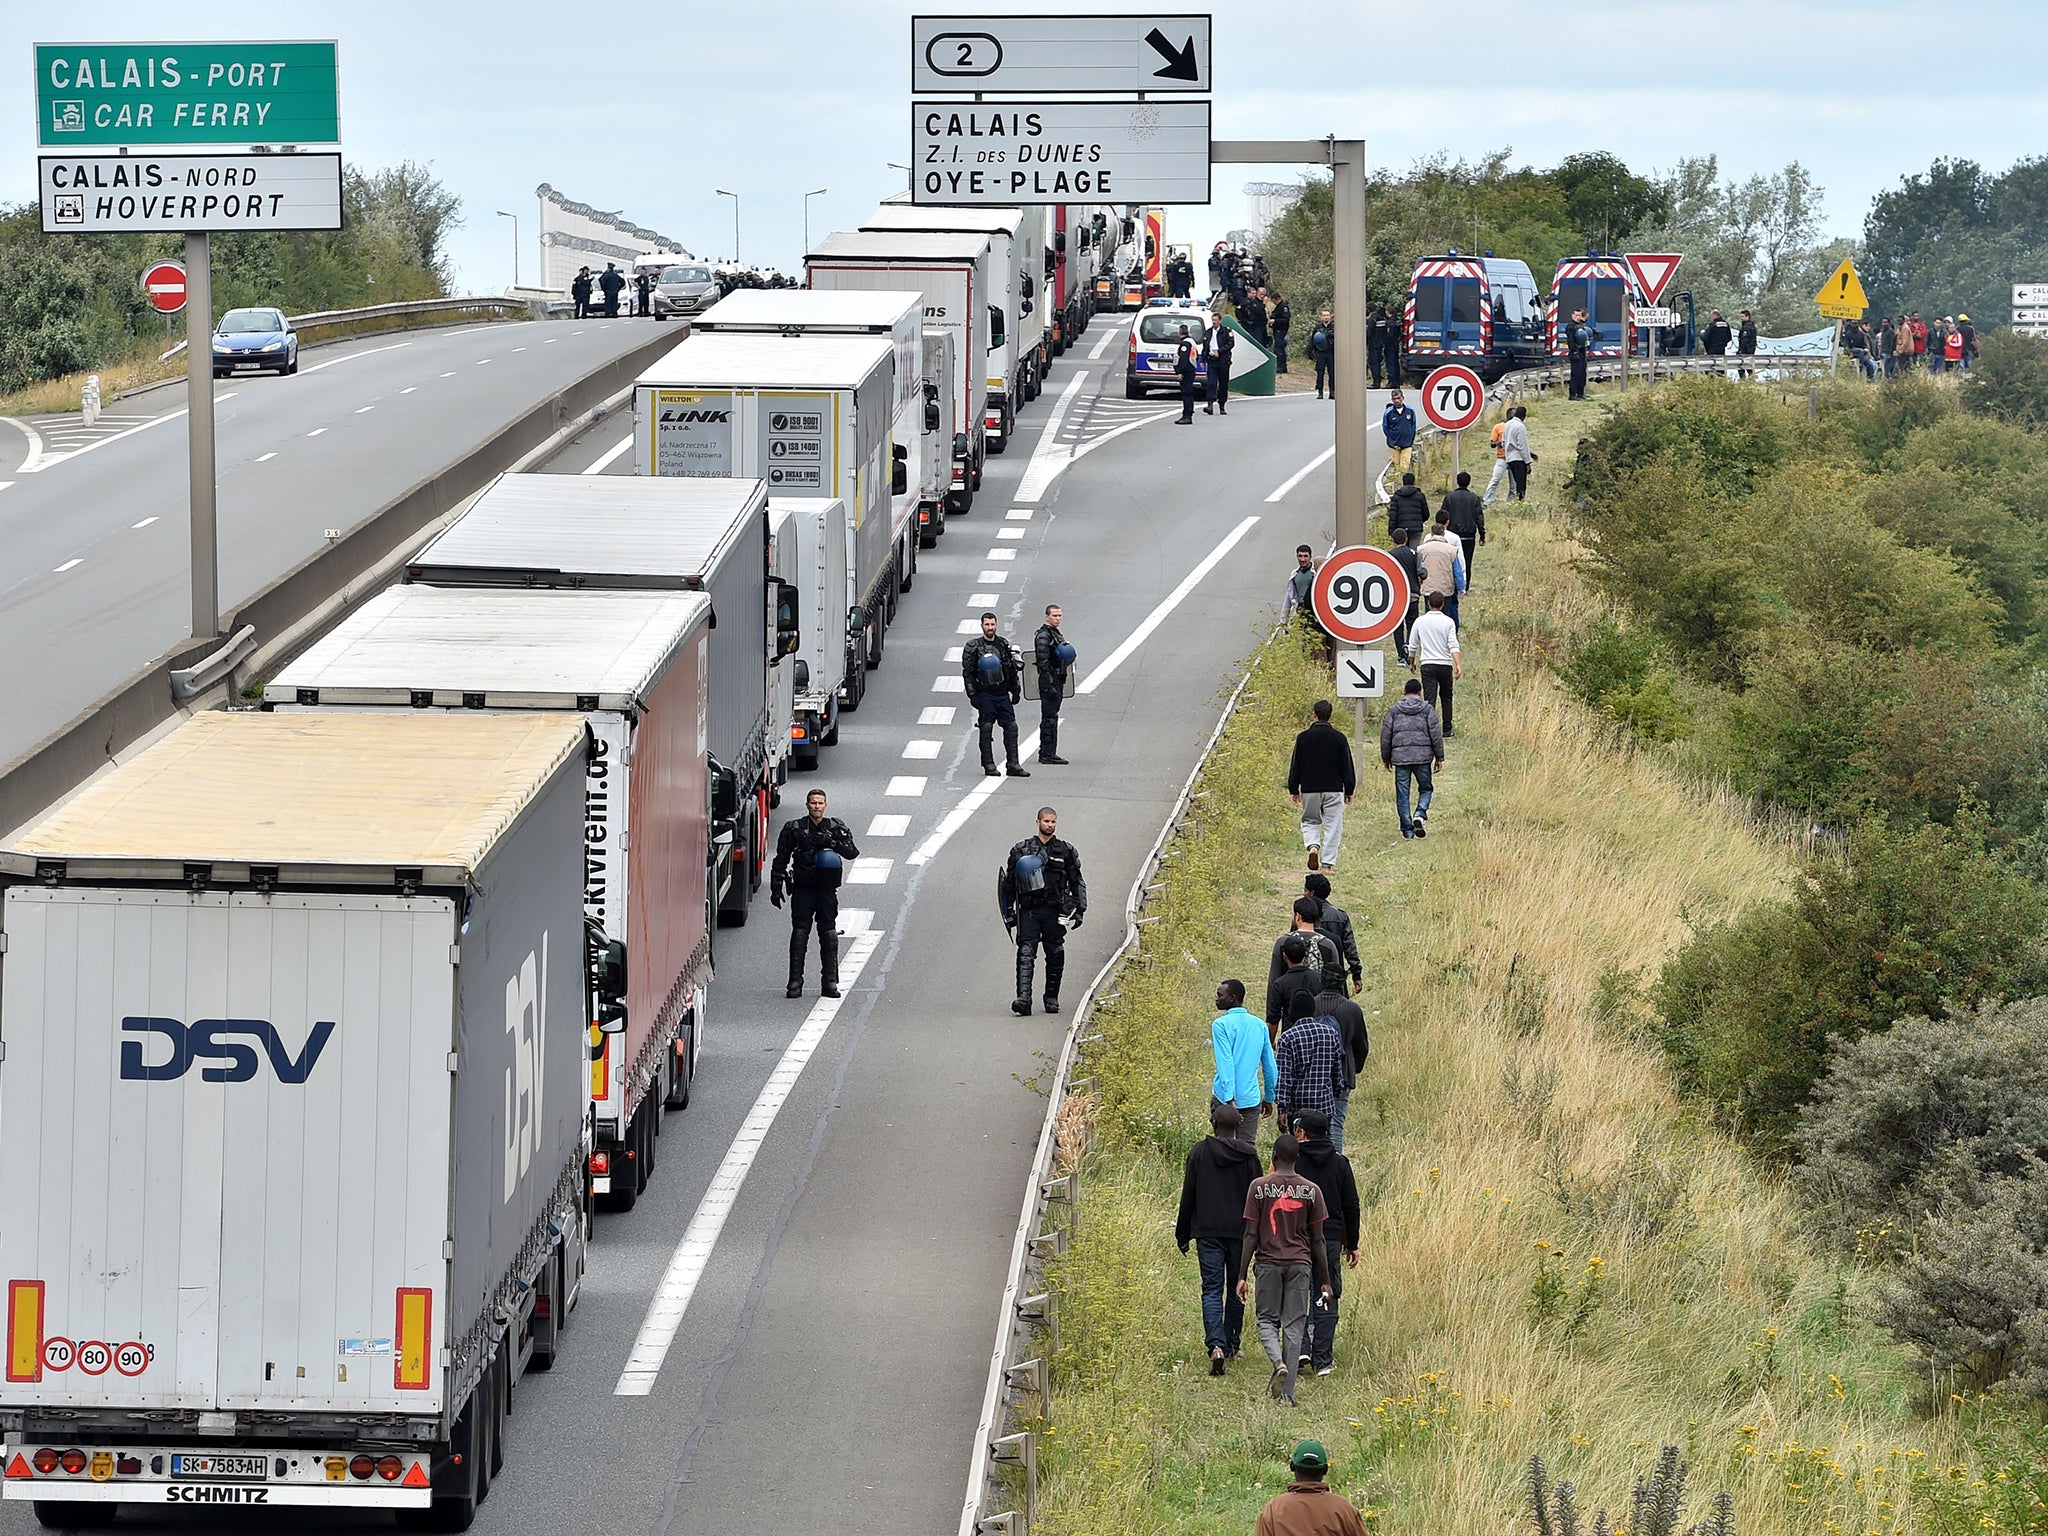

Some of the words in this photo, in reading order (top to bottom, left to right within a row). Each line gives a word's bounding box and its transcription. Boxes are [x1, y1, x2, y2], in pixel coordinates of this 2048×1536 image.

[957, 43, 973, 66] 2
[94, 103, 154, 128] CAR
[173, 102, 272, 127] FERRY
[925, 113, 1043, 137] CALAIS
[925, 144, 965, 163] Z.I.
[976, 150, 1006, 163] DES
[1017, 144, 1102, 163] DUNES
[925, 170, 1112, 194] OYE-PLAGE
[95, 194, 284, 219] HOVERPORT
[921, 306, 947, 317] ns
[1636, 308, 1658, 316] CÉDEZ
[1660, 309, 1669, 317] LE
[1637, 317, 1667, 325] PASSAGE
[1436, 385, 1472, 411] 70
[659, 410, 733, 422] LINK
[790, 416, 801, 425] ISO
[802, 416, 819, 425] 9001
[788, 442, 799, 451] ISO
[800, 442, 819, 451] 14001
[1332, 575, 1390, 615] 90
[120, 1016, 337, 1084] DSV
[504, 929, 549, 1205] DSV
[1254, 1183, 1316, 1203] JAMAICA
[48, 1346, 69, 1361] 70
[84, 1350, 105, 1364] 80
[121, 1351, 142, 1366] 90
[182, 1457, 199, 1473] SK
[166, 1486, 269, 1503] SCHMITZ
